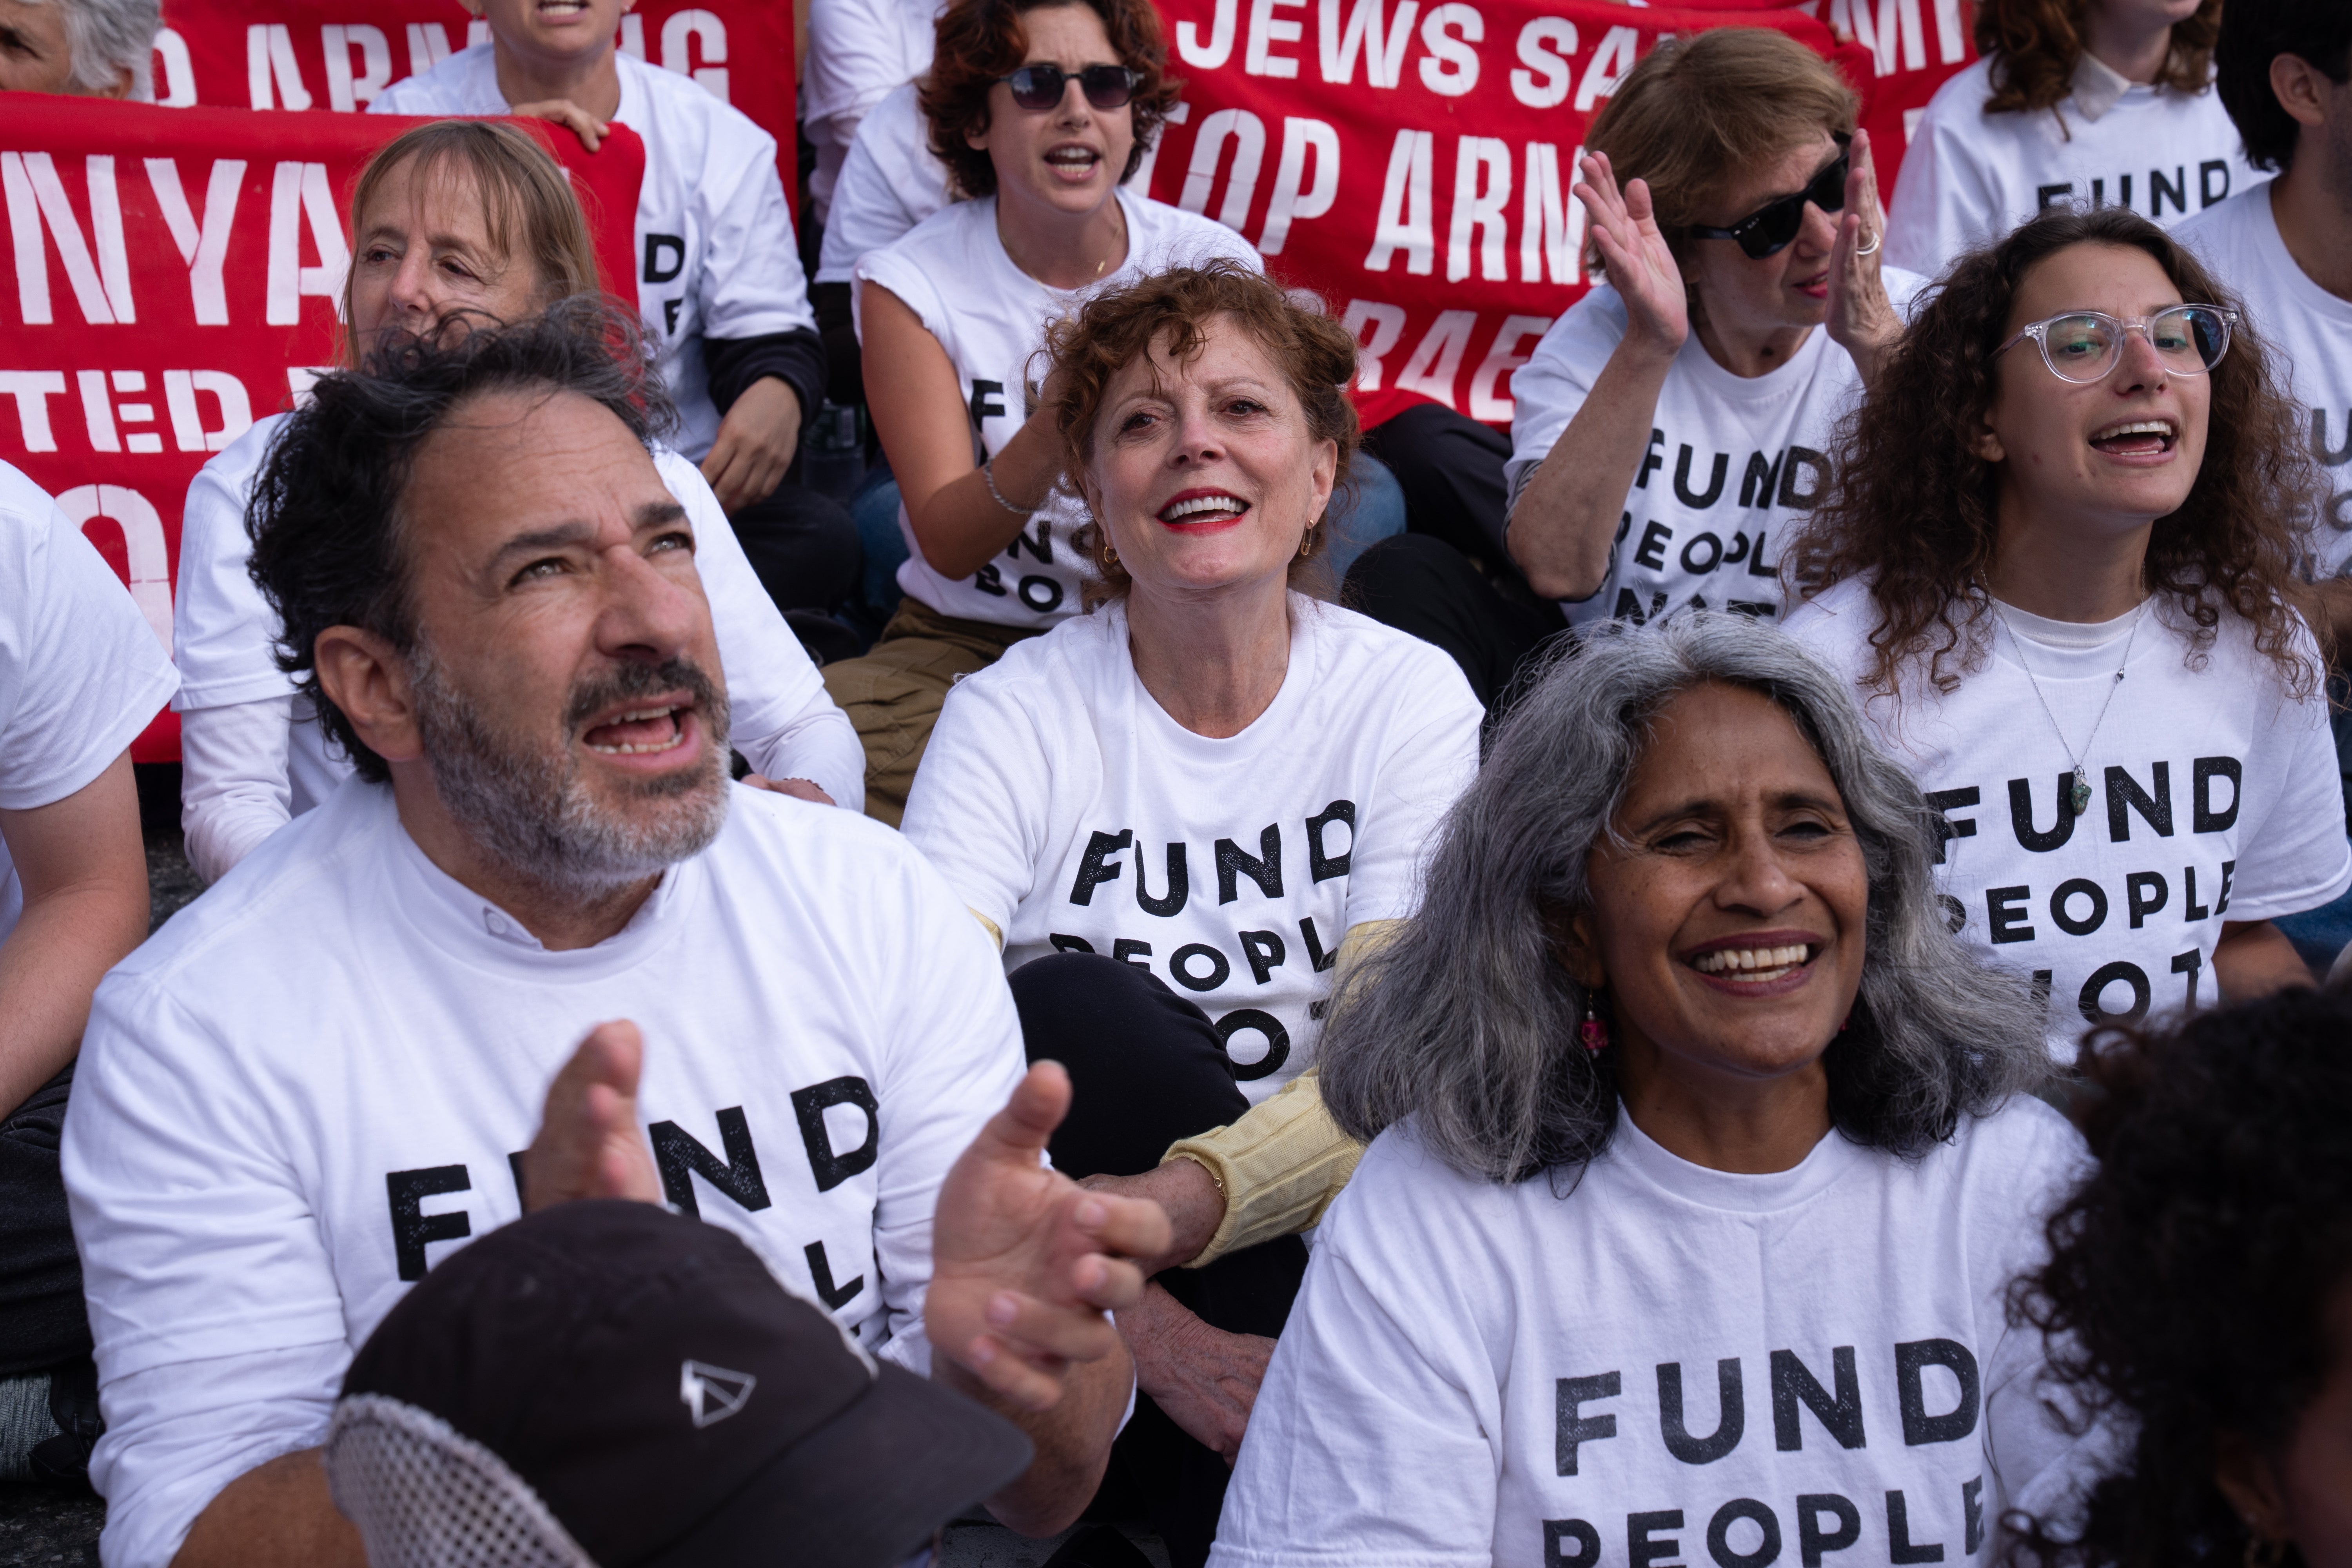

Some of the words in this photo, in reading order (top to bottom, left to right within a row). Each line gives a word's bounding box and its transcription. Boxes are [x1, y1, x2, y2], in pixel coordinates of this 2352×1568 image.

[1176, 0, 1486, 97] JEWS
[1510, 16, 1678, 112] SA
[1635, 428, 1833, 510] FUND
[1069, 799, 1356, 917] FUND
[1924, 756, 2243, 865] FUND
[2029, 947, 2202, 1027] OT
[385, 1075, 880, 1282] FND
[1555, 1338, 1980, 1477] FUND
